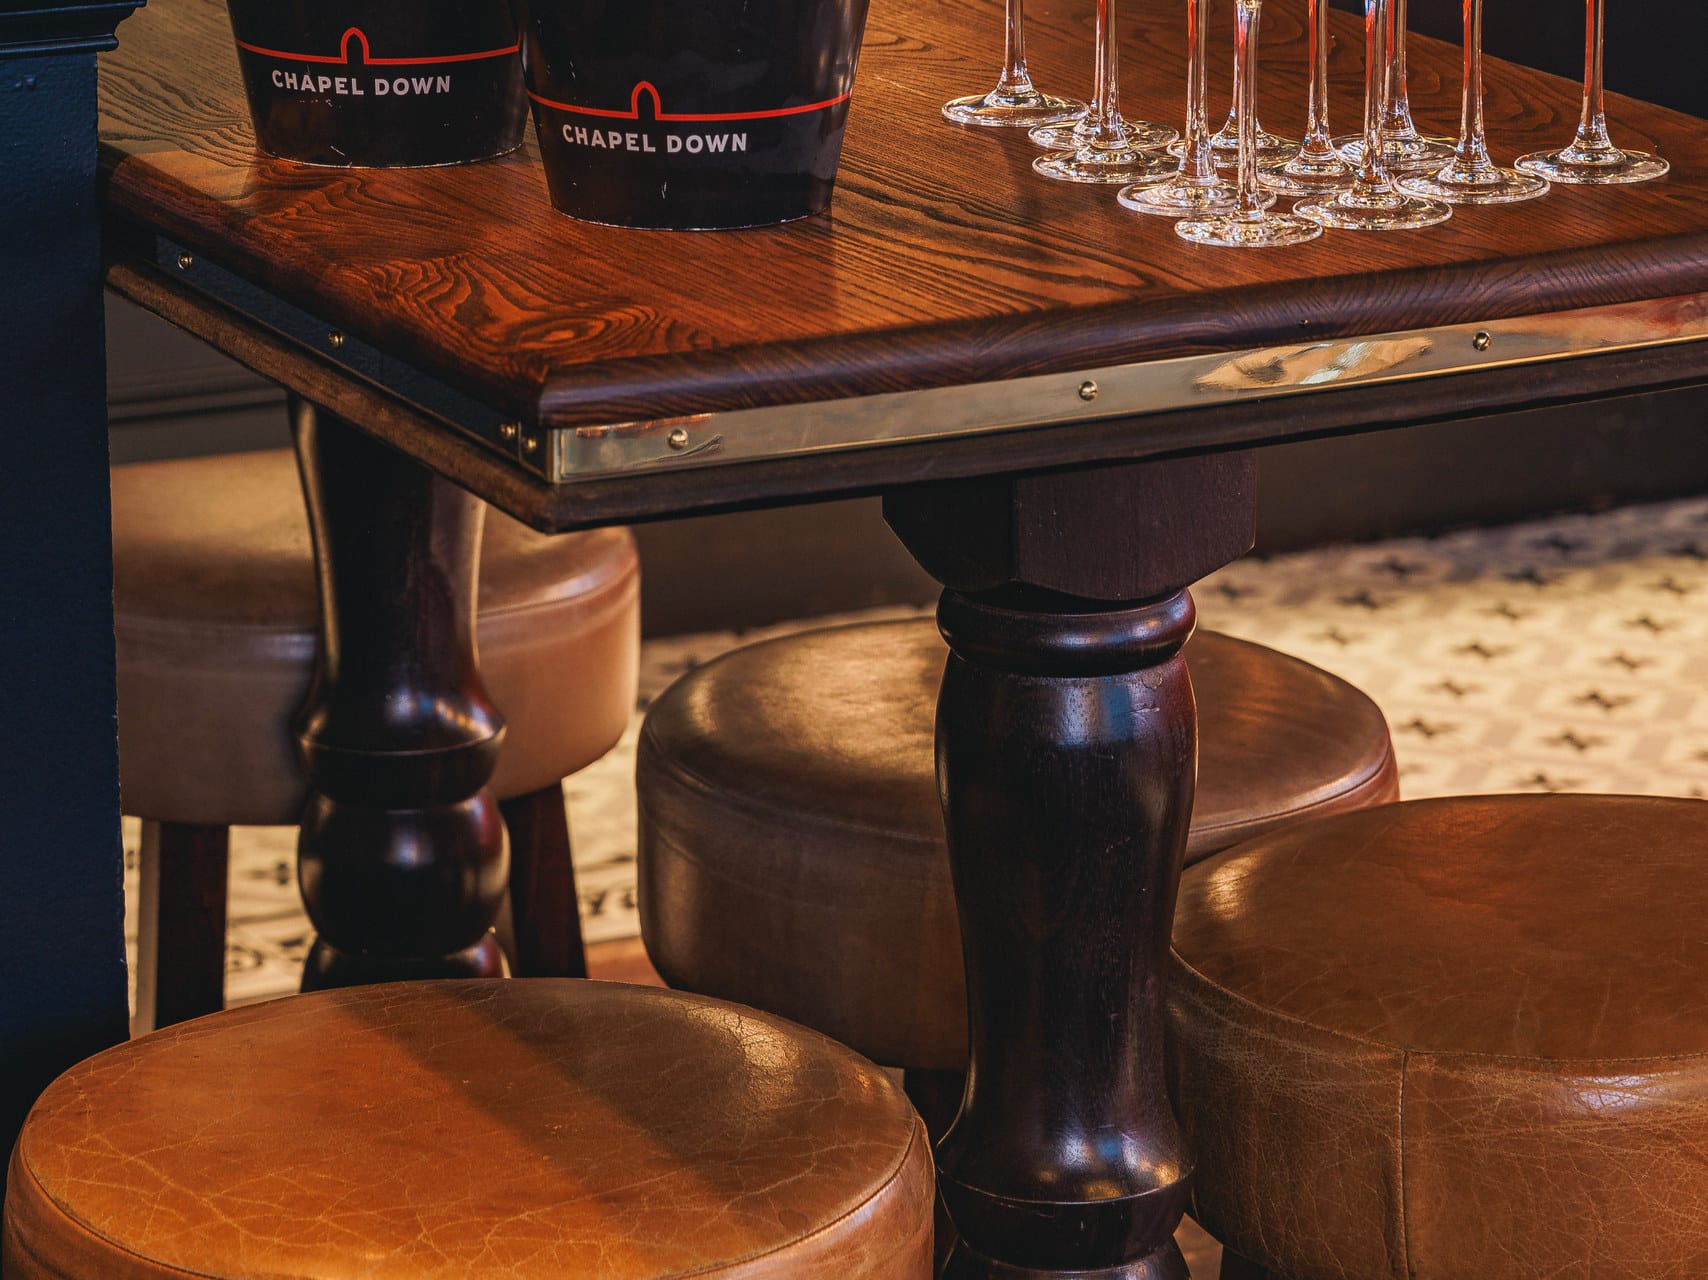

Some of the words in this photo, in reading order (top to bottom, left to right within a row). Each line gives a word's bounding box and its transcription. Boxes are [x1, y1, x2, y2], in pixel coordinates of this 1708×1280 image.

[271, 70, 365, 95] CHAPEL
[374, 75, 450, 96] DOWN
[562, 124, 656, 152] CHAPEL
[666, 133, 747, 153] DOWN
